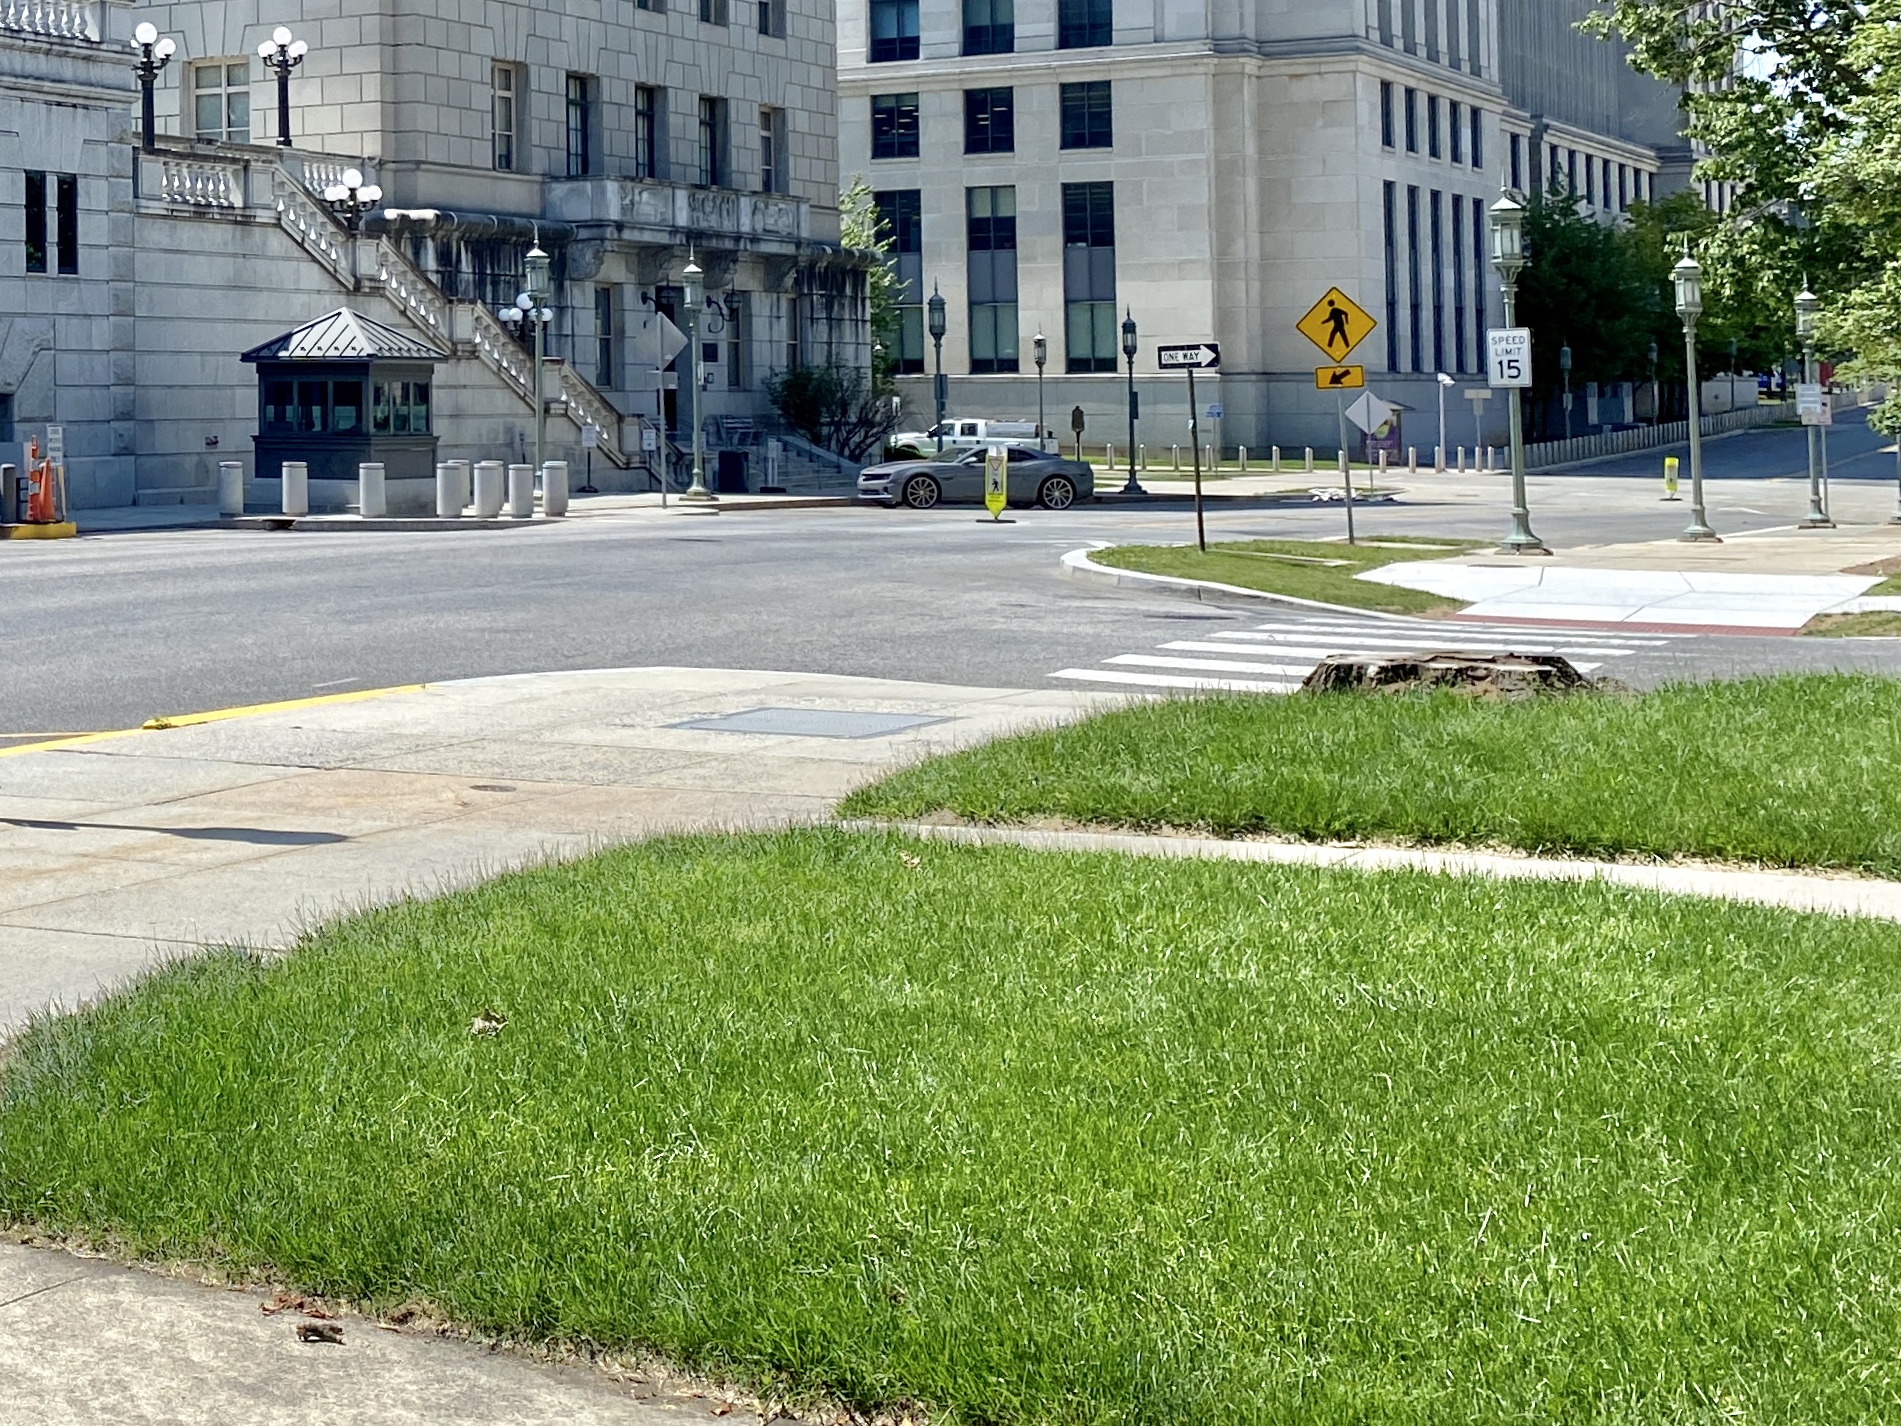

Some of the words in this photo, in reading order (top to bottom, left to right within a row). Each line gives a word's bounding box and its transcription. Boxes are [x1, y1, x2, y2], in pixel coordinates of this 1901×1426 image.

[1491, 335, 1526, 345] SPEED
[1163, 352, 1180, 362] ONE
[1182, 351, 1200, 361] WAY
[1495, 347, 1522, 357] LIMIT
[1497, 359, 1521, 379] 15
